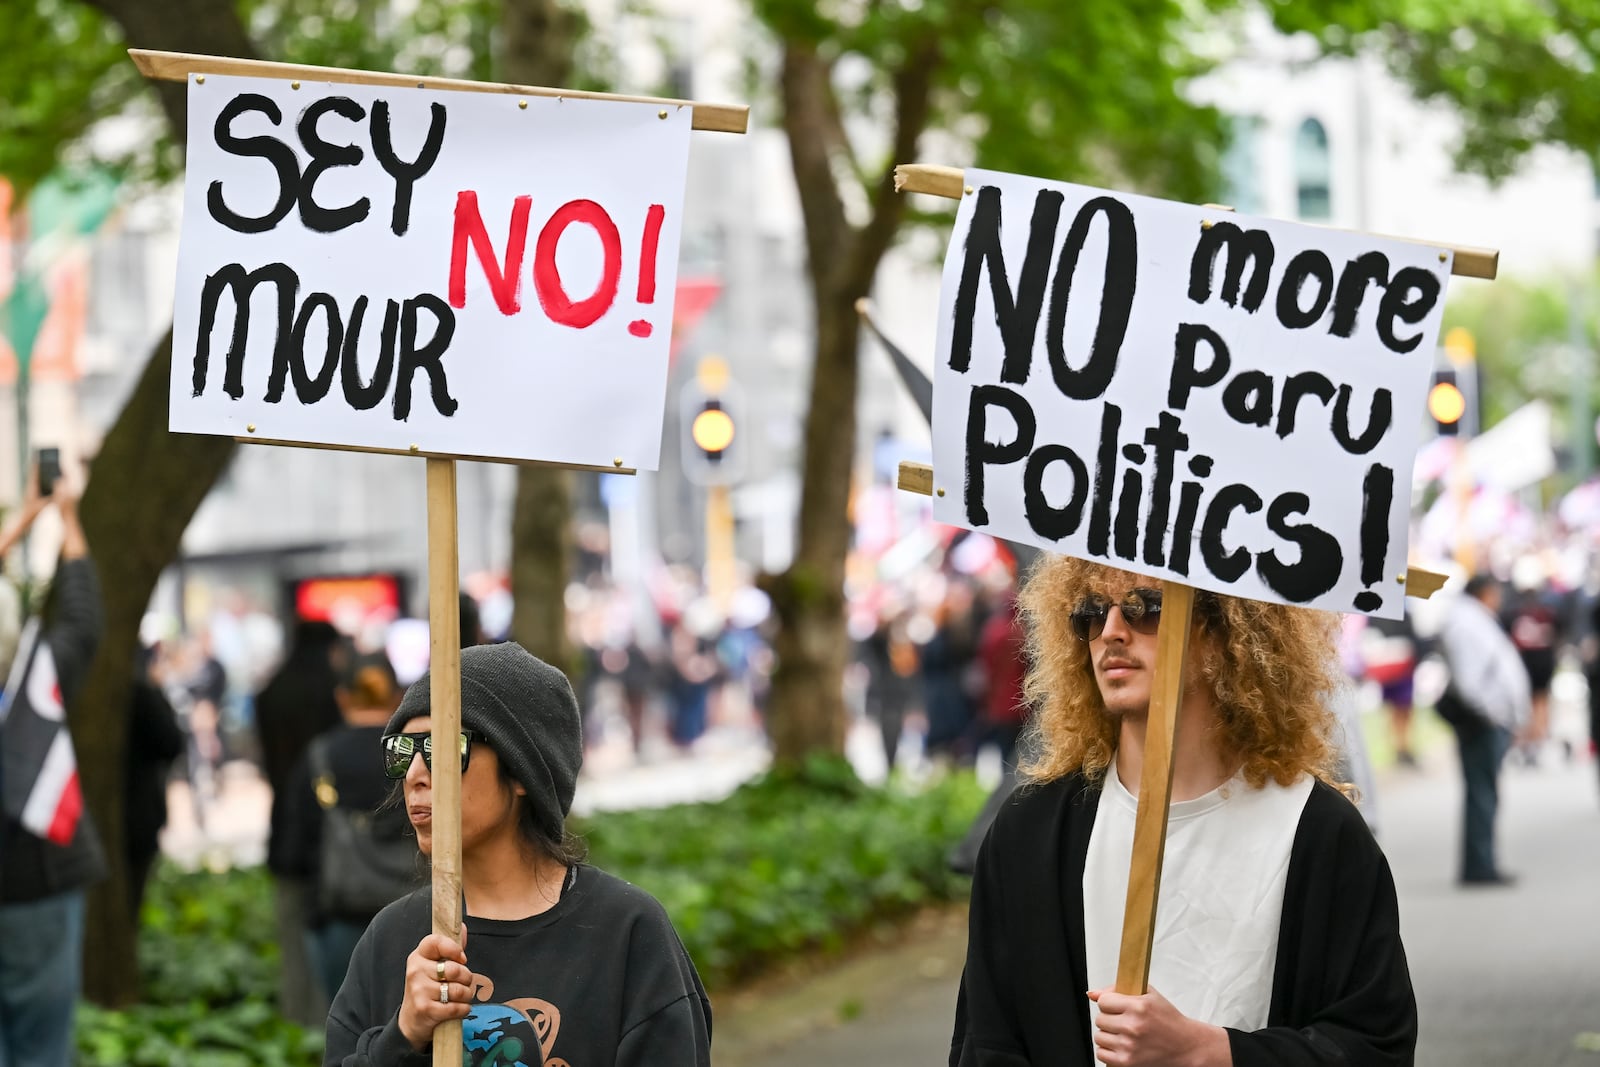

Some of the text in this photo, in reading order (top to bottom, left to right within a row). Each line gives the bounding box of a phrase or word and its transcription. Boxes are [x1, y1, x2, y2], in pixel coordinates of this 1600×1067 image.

[206, 93, 447, 237] SEY
[191, 262, 459, 422] MOUR
[448, 190, 666, 339] NO!
[947, 185, 1441, 401] NO more
[963, 384, 1394, 613] Politics!
